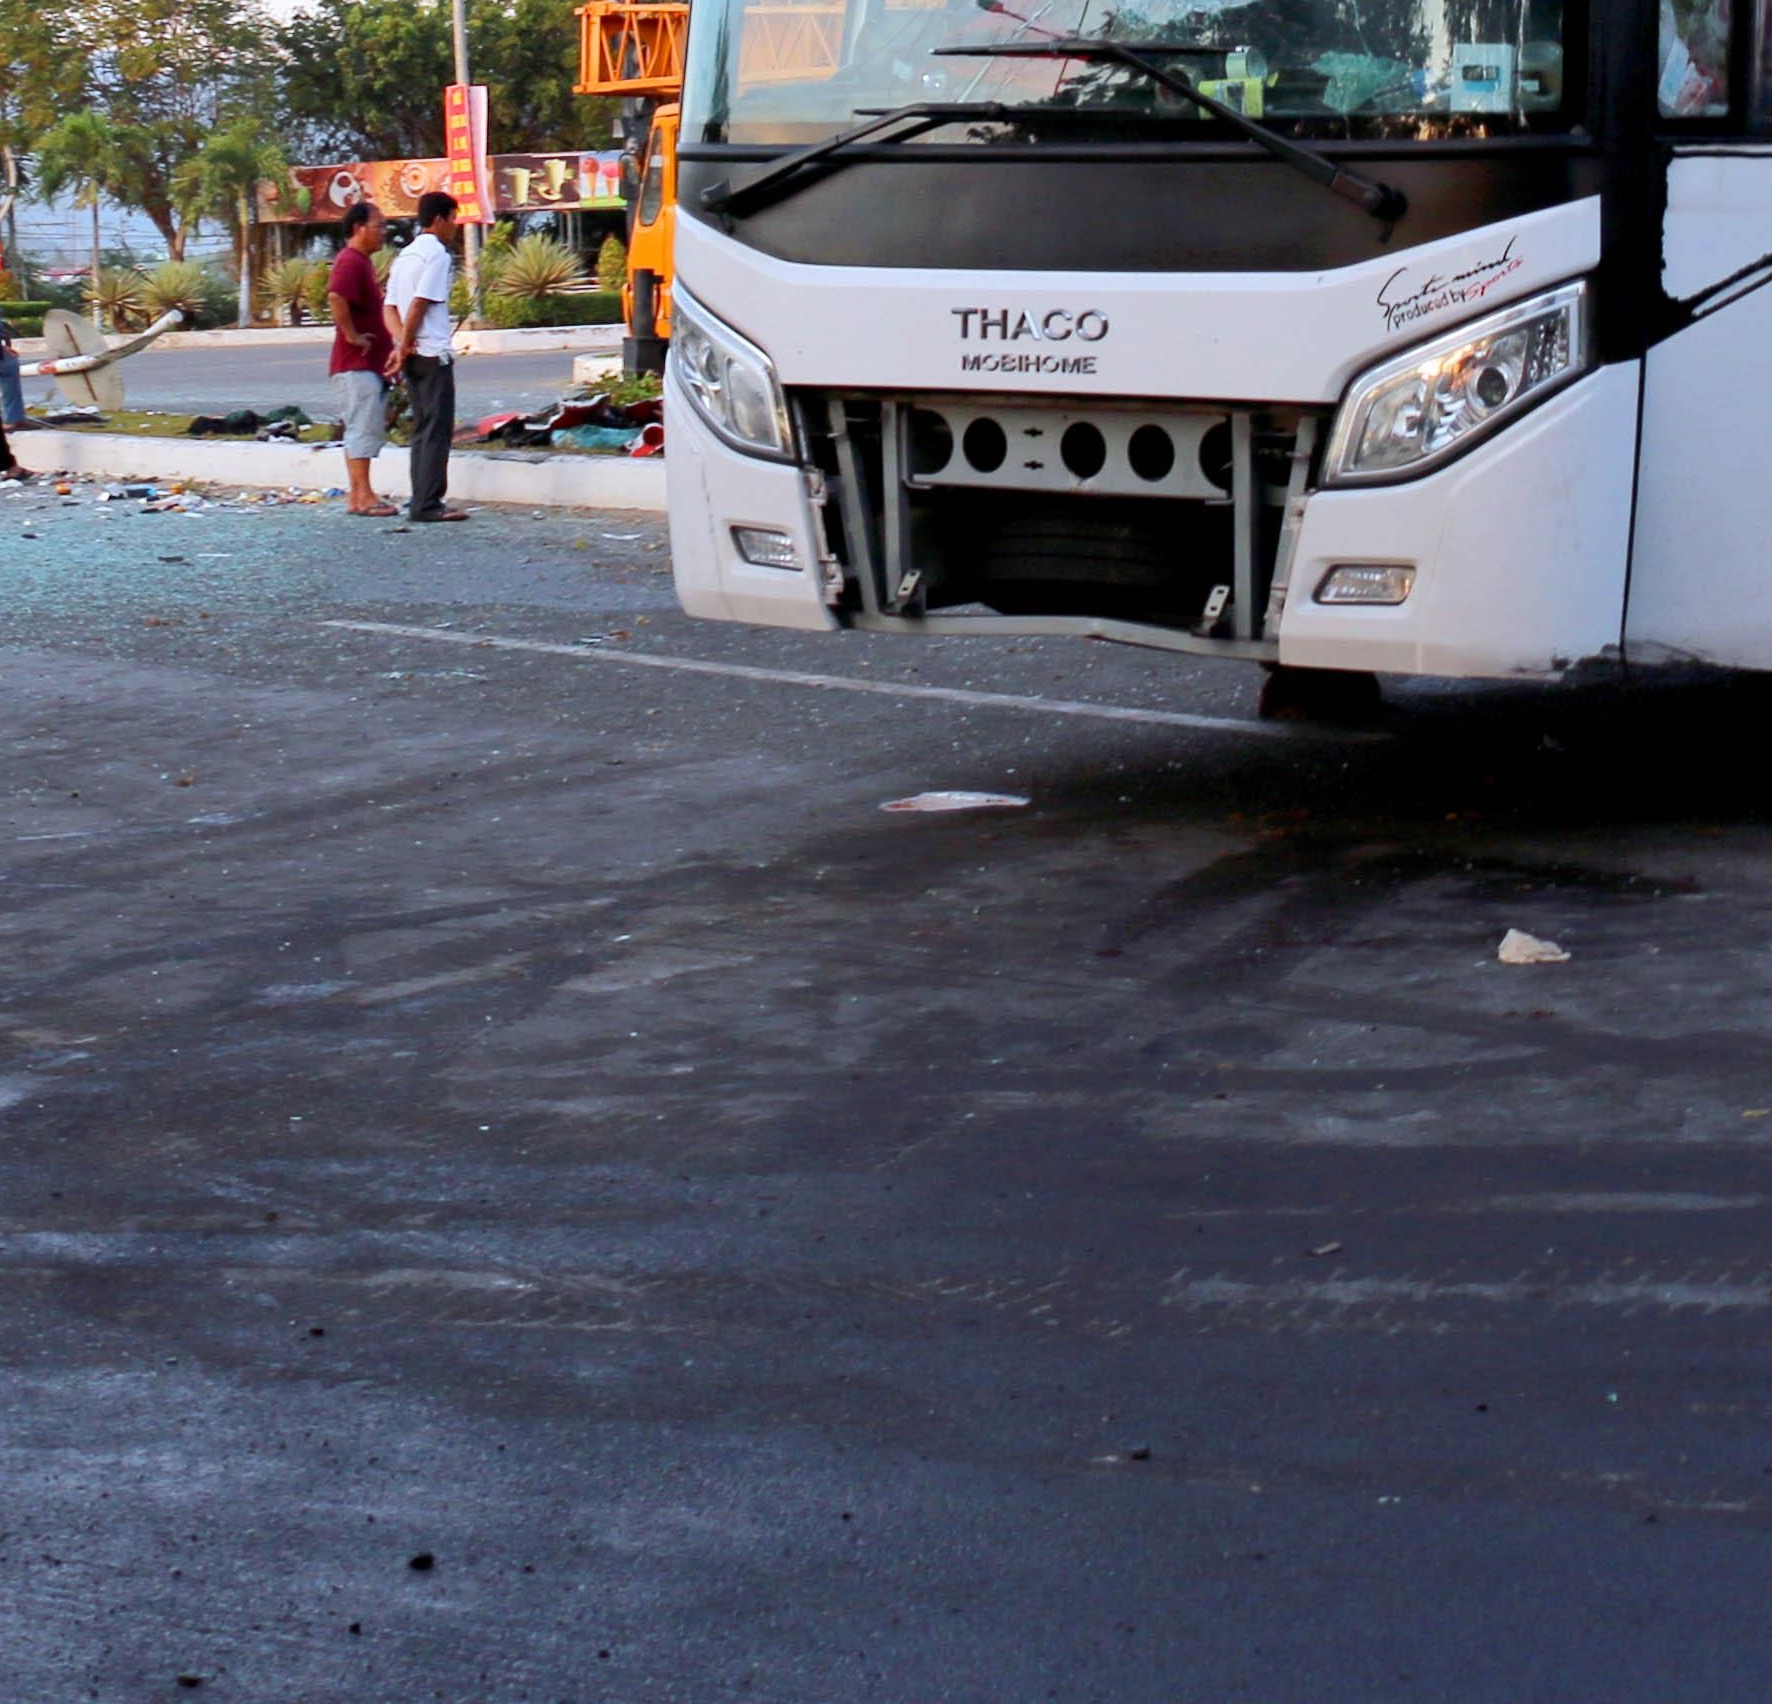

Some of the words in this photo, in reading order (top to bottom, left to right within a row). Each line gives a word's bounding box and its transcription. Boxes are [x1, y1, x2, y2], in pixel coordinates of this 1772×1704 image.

[1392, 293, 1449, 329] produced
[1450, 288, 1467, 304] by
[1465, 255, 1524, 301] Sports
[951, 307, 1109, 342] THACO
[961, 353, 1098, 375] MOBIHOME
